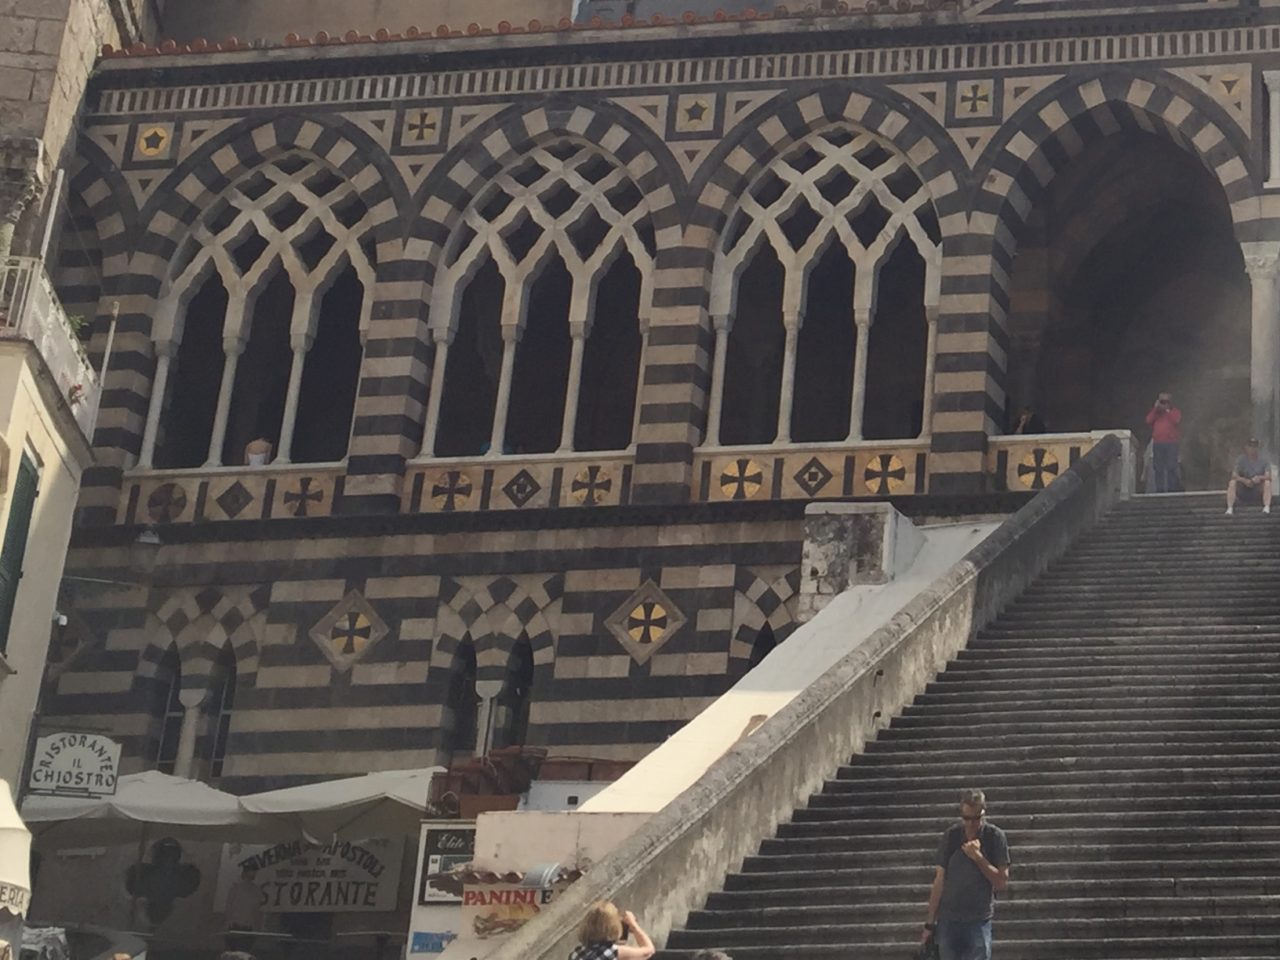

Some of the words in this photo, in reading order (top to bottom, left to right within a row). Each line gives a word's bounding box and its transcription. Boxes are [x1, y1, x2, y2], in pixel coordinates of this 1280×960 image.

[40, 735, 113, 772] RISTORANTE
[72, 758, 82, 769] IL
[32, 769, 115, 787] CHIOSTRO
[258, 881, 379, 907] STORANTE
[463, 889, 537, 906] PANINI
